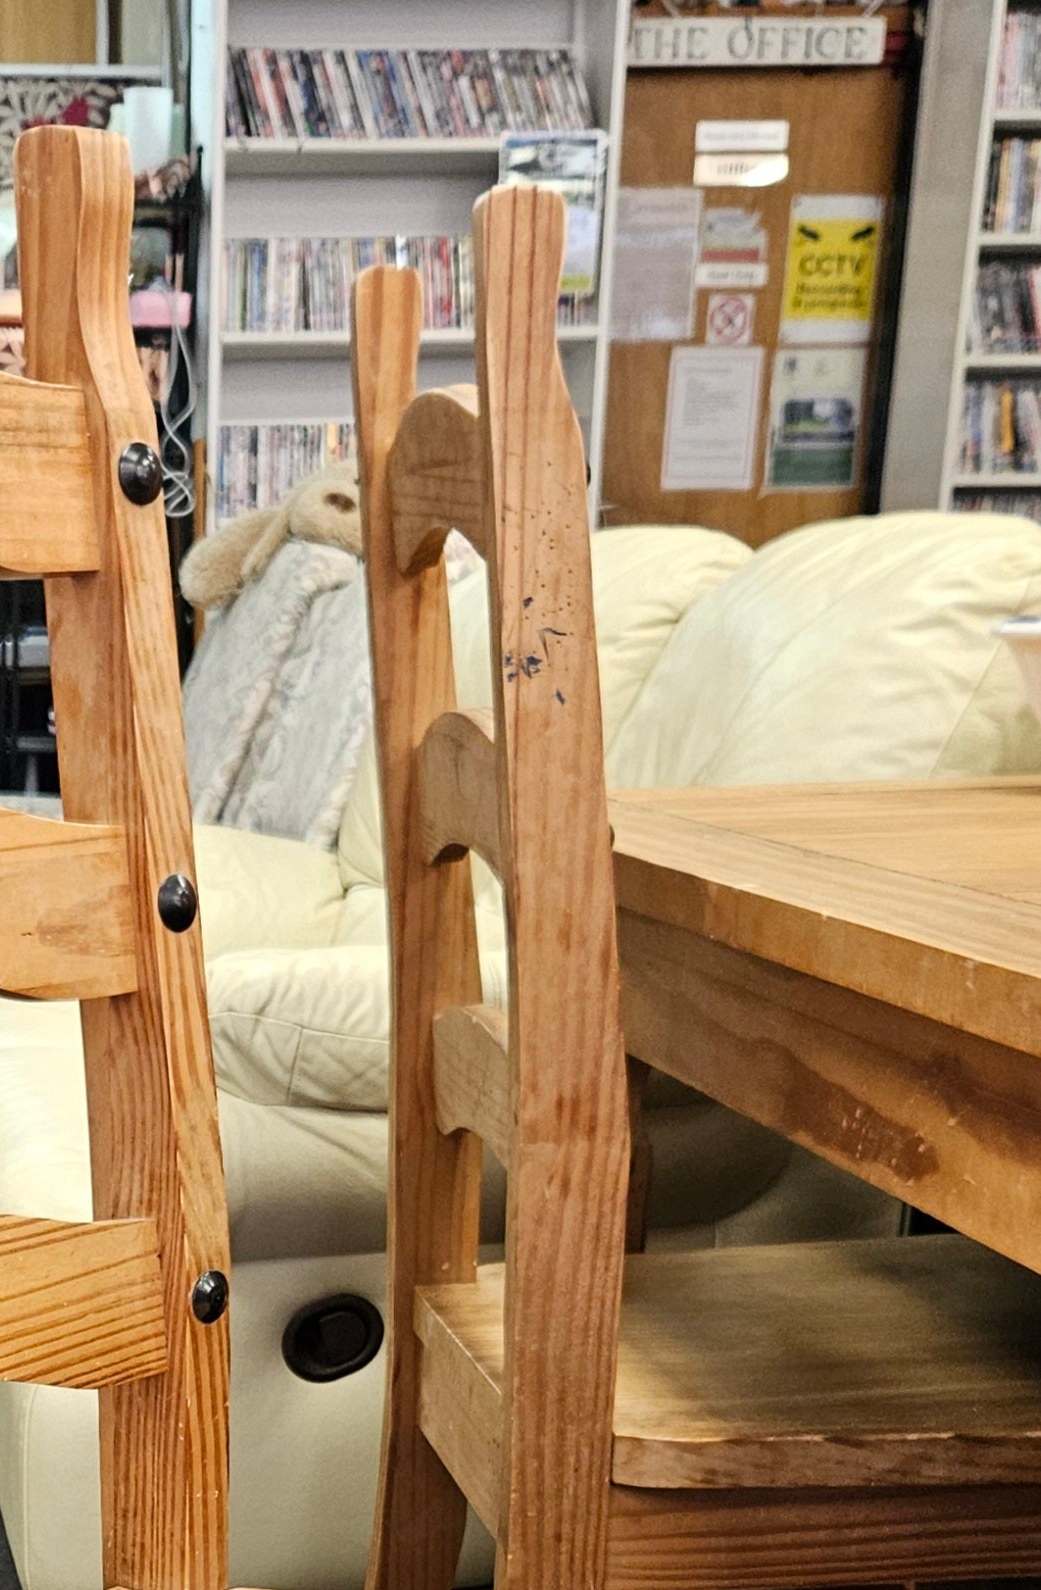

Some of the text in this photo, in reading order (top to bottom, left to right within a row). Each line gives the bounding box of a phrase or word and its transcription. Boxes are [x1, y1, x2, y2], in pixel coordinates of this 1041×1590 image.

[634, 25, 867, 60] THE OFFICE
[798, 253, 869, 277] CCTV
